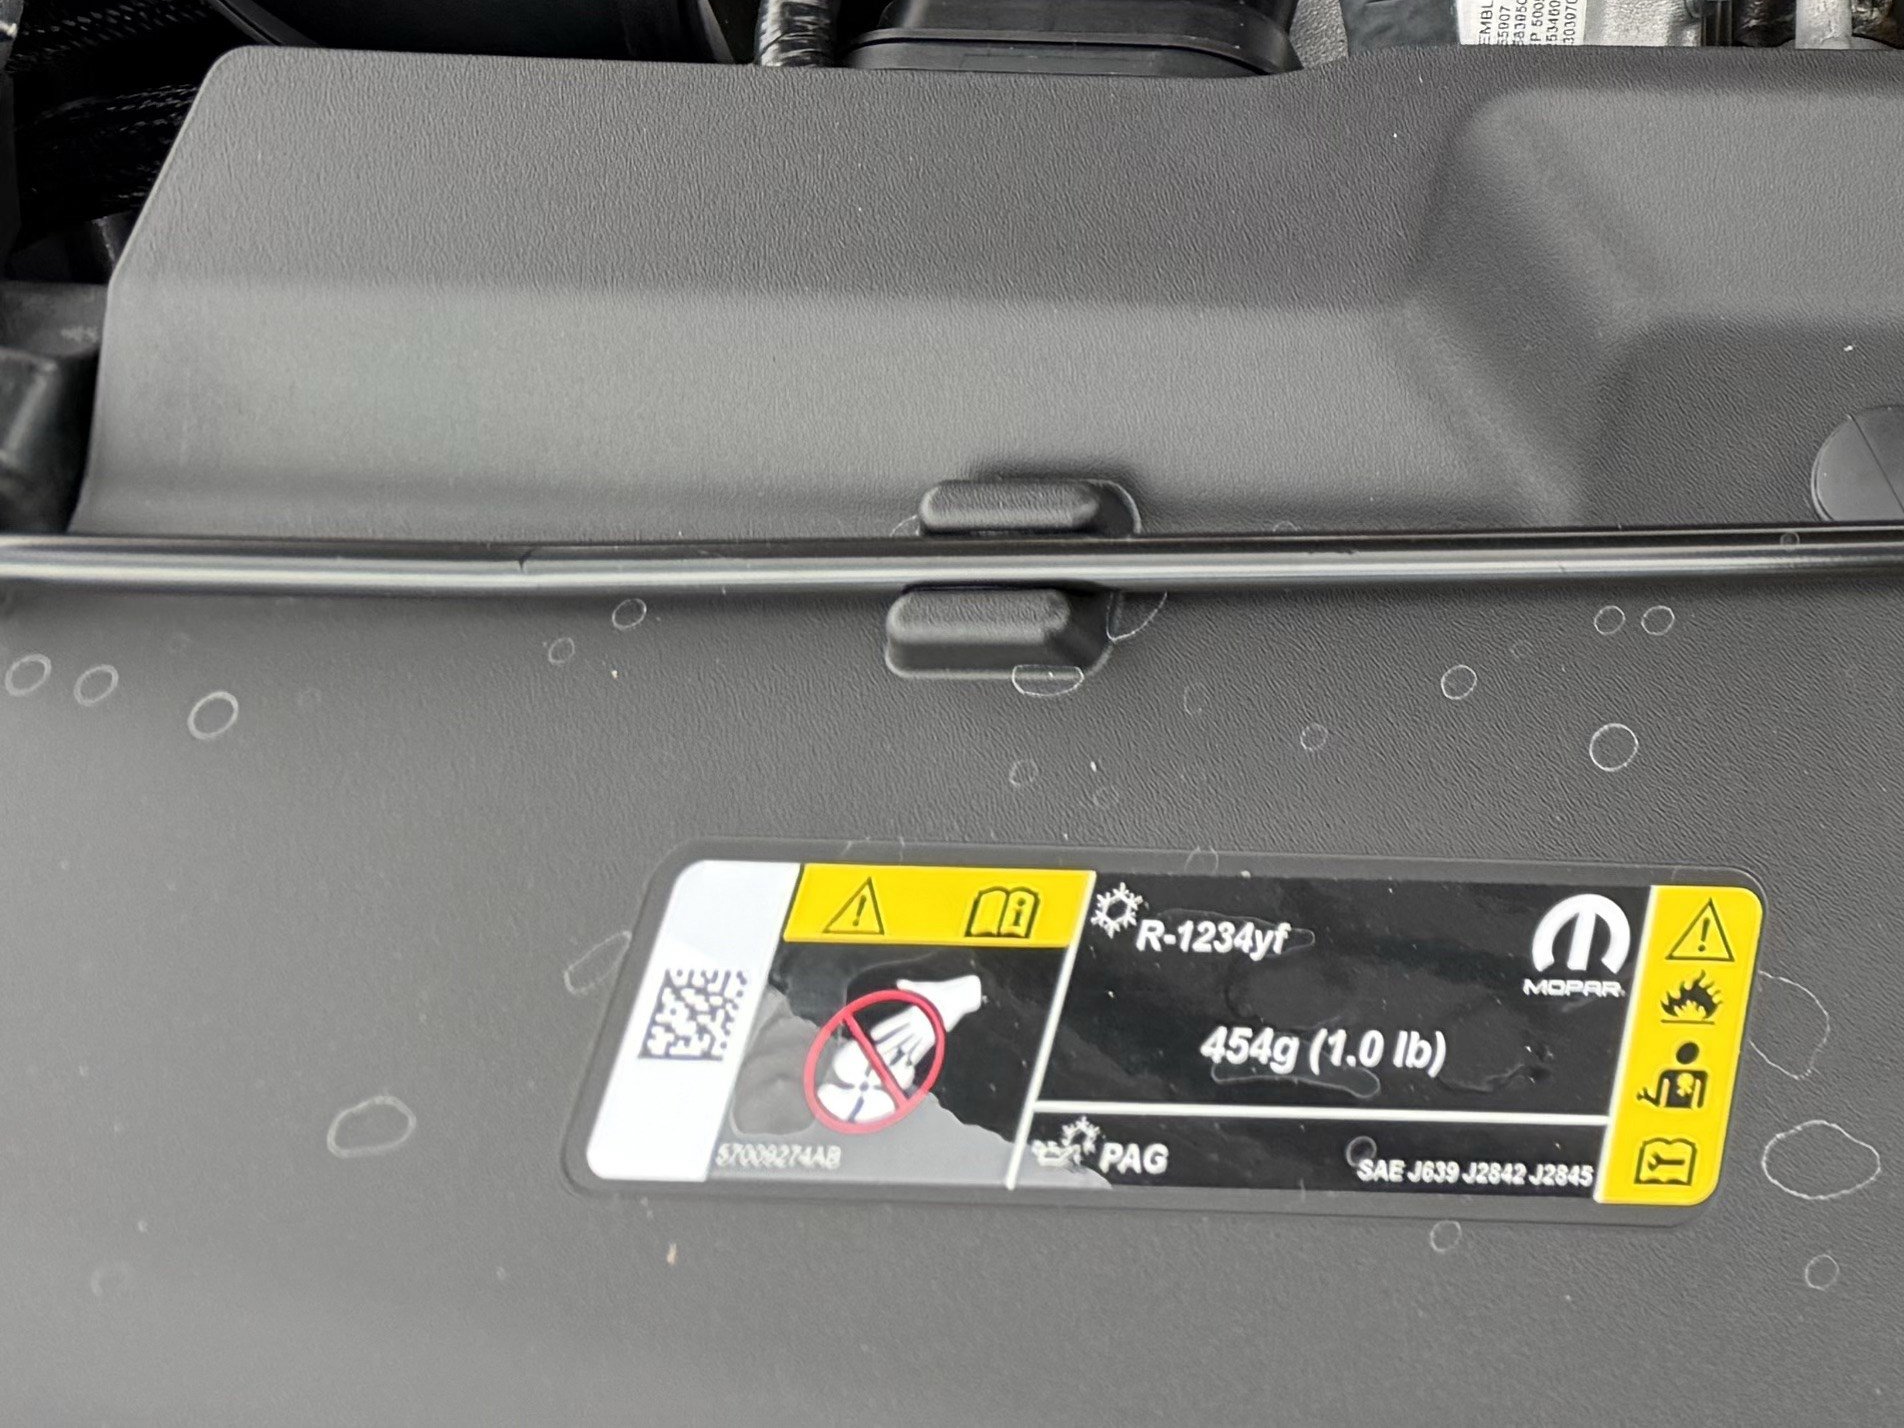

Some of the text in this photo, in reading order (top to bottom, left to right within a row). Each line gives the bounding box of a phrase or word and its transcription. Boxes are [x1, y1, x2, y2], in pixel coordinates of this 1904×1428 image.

[1135, 918, 1290, 959] R-1234yf
[1523, 978, 1622, 996] MOPAR
[1200, 1027, 1445, 1077] 454g (1.0 lb)
[1100, 1144, 1593, 1187] PAG SAE J639 J2842 J2845
